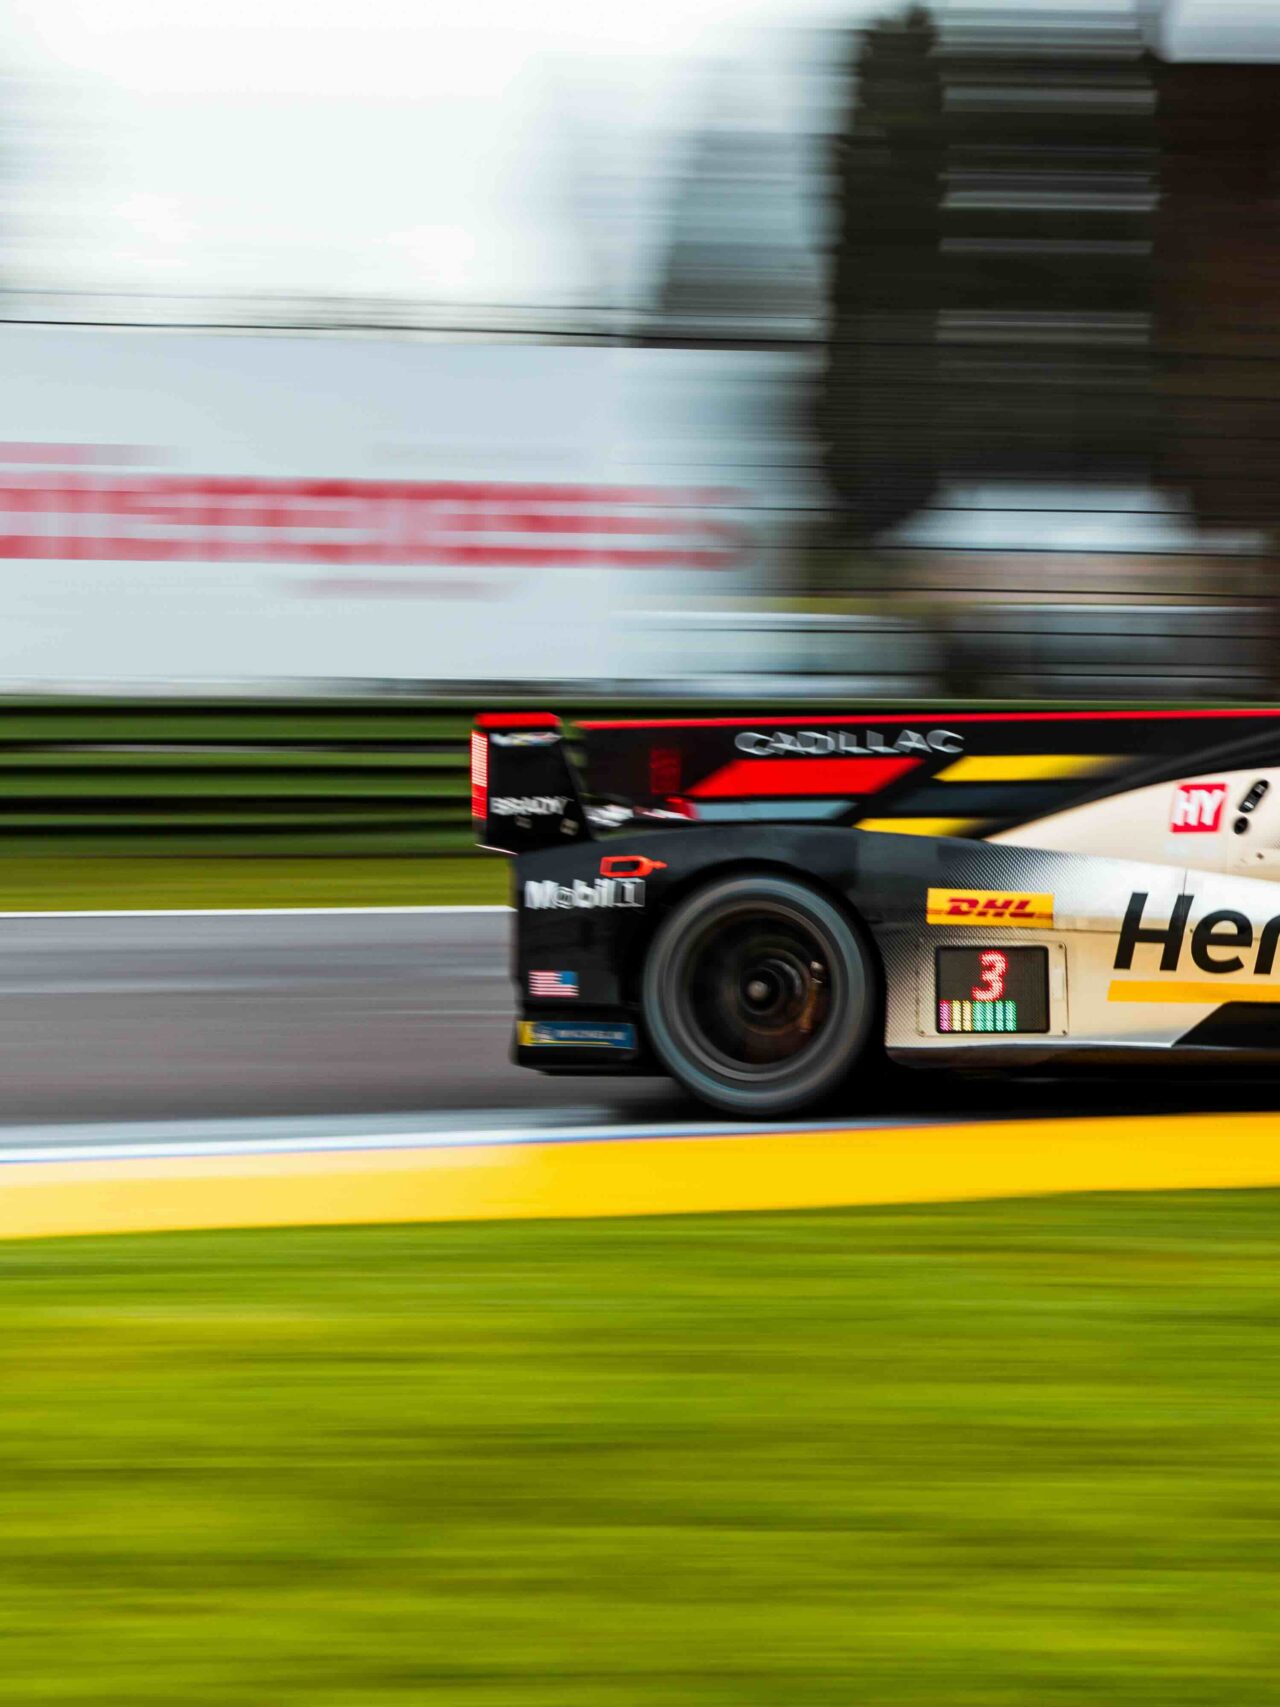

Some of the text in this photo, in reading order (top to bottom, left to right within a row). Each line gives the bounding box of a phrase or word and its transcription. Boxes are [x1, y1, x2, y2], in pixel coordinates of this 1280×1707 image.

[734, 729, 964, 756] CADILLAC
[1172, 788, 1226, 826] HY
[946, 897, 1036, 918] DHL
[971, 949, 1009, 1002] 3
